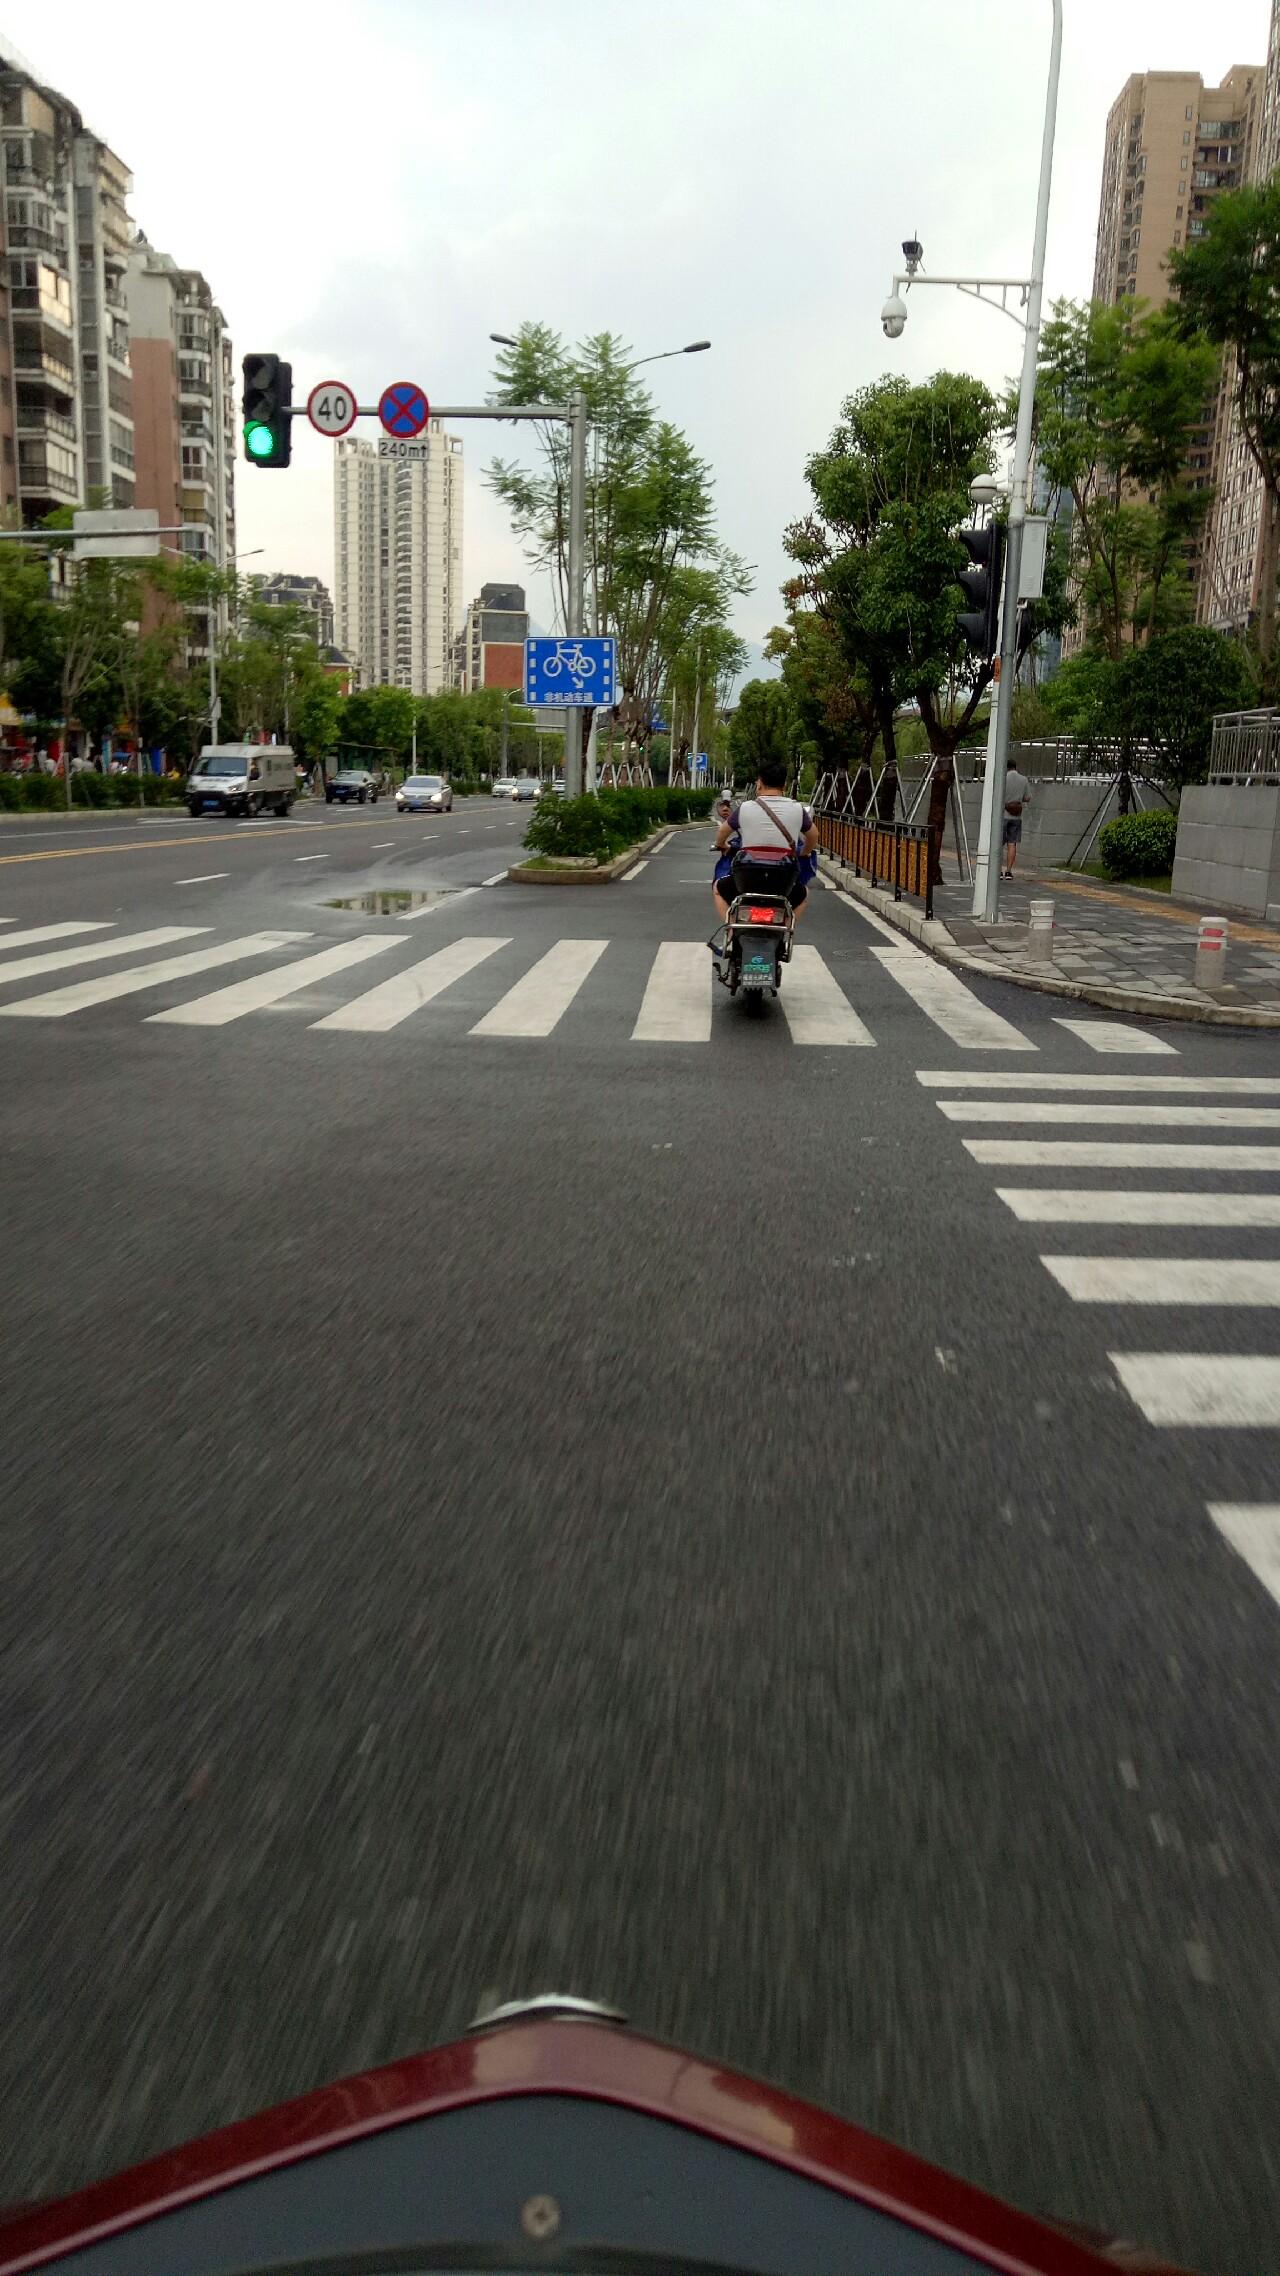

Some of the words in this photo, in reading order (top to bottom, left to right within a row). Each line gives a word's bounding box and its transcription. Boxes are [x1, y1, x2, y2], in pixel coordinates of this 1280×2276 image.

[318, 396, 347, 421] 40
[543, 691, 594, 703] 非机动车道
